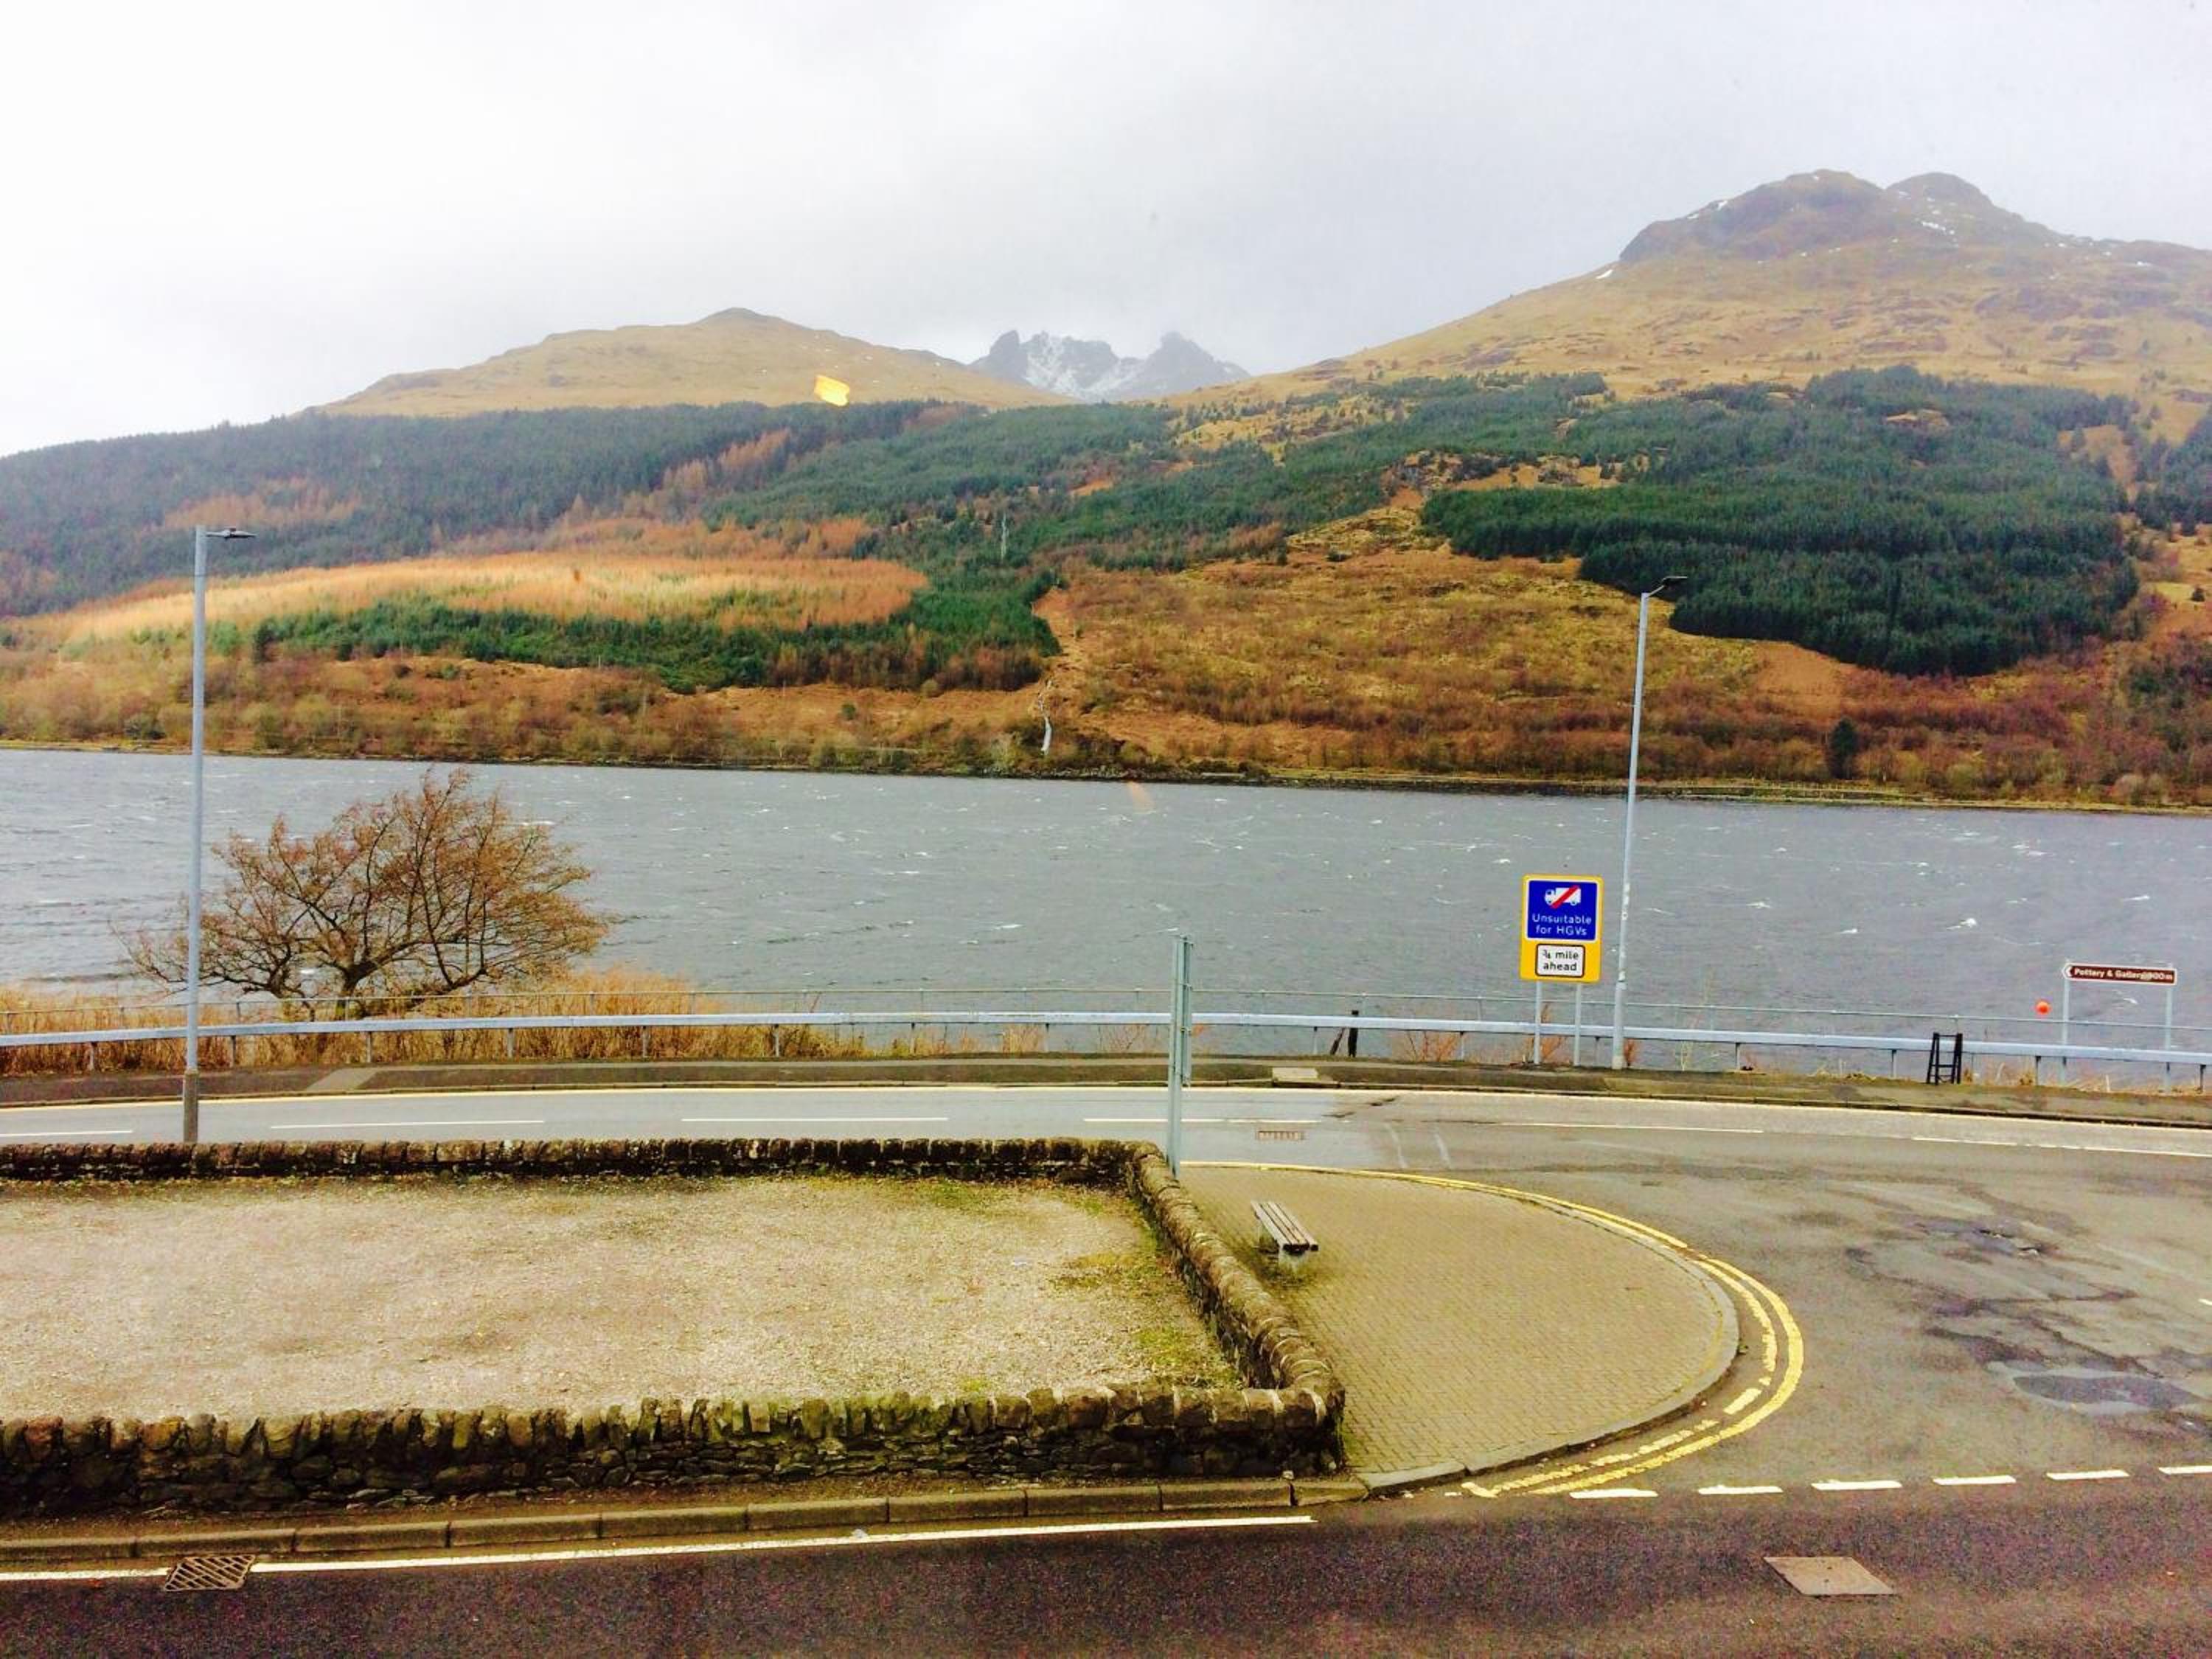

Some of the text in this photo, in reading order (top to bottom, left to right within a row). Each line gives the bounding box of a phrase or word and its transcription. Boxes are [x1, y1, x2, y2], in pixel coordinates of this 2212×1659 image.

[1531, 914, 1592, 925] Unsuitable
[1536, 924, 1587, 936] for HGVs
[1555, 950, 1579, 960] mile
[1543, 961, 1577, 971] ahead
[2074, 968, 2105, 978] Pottery
[2107, 969, 2114, 978] &
